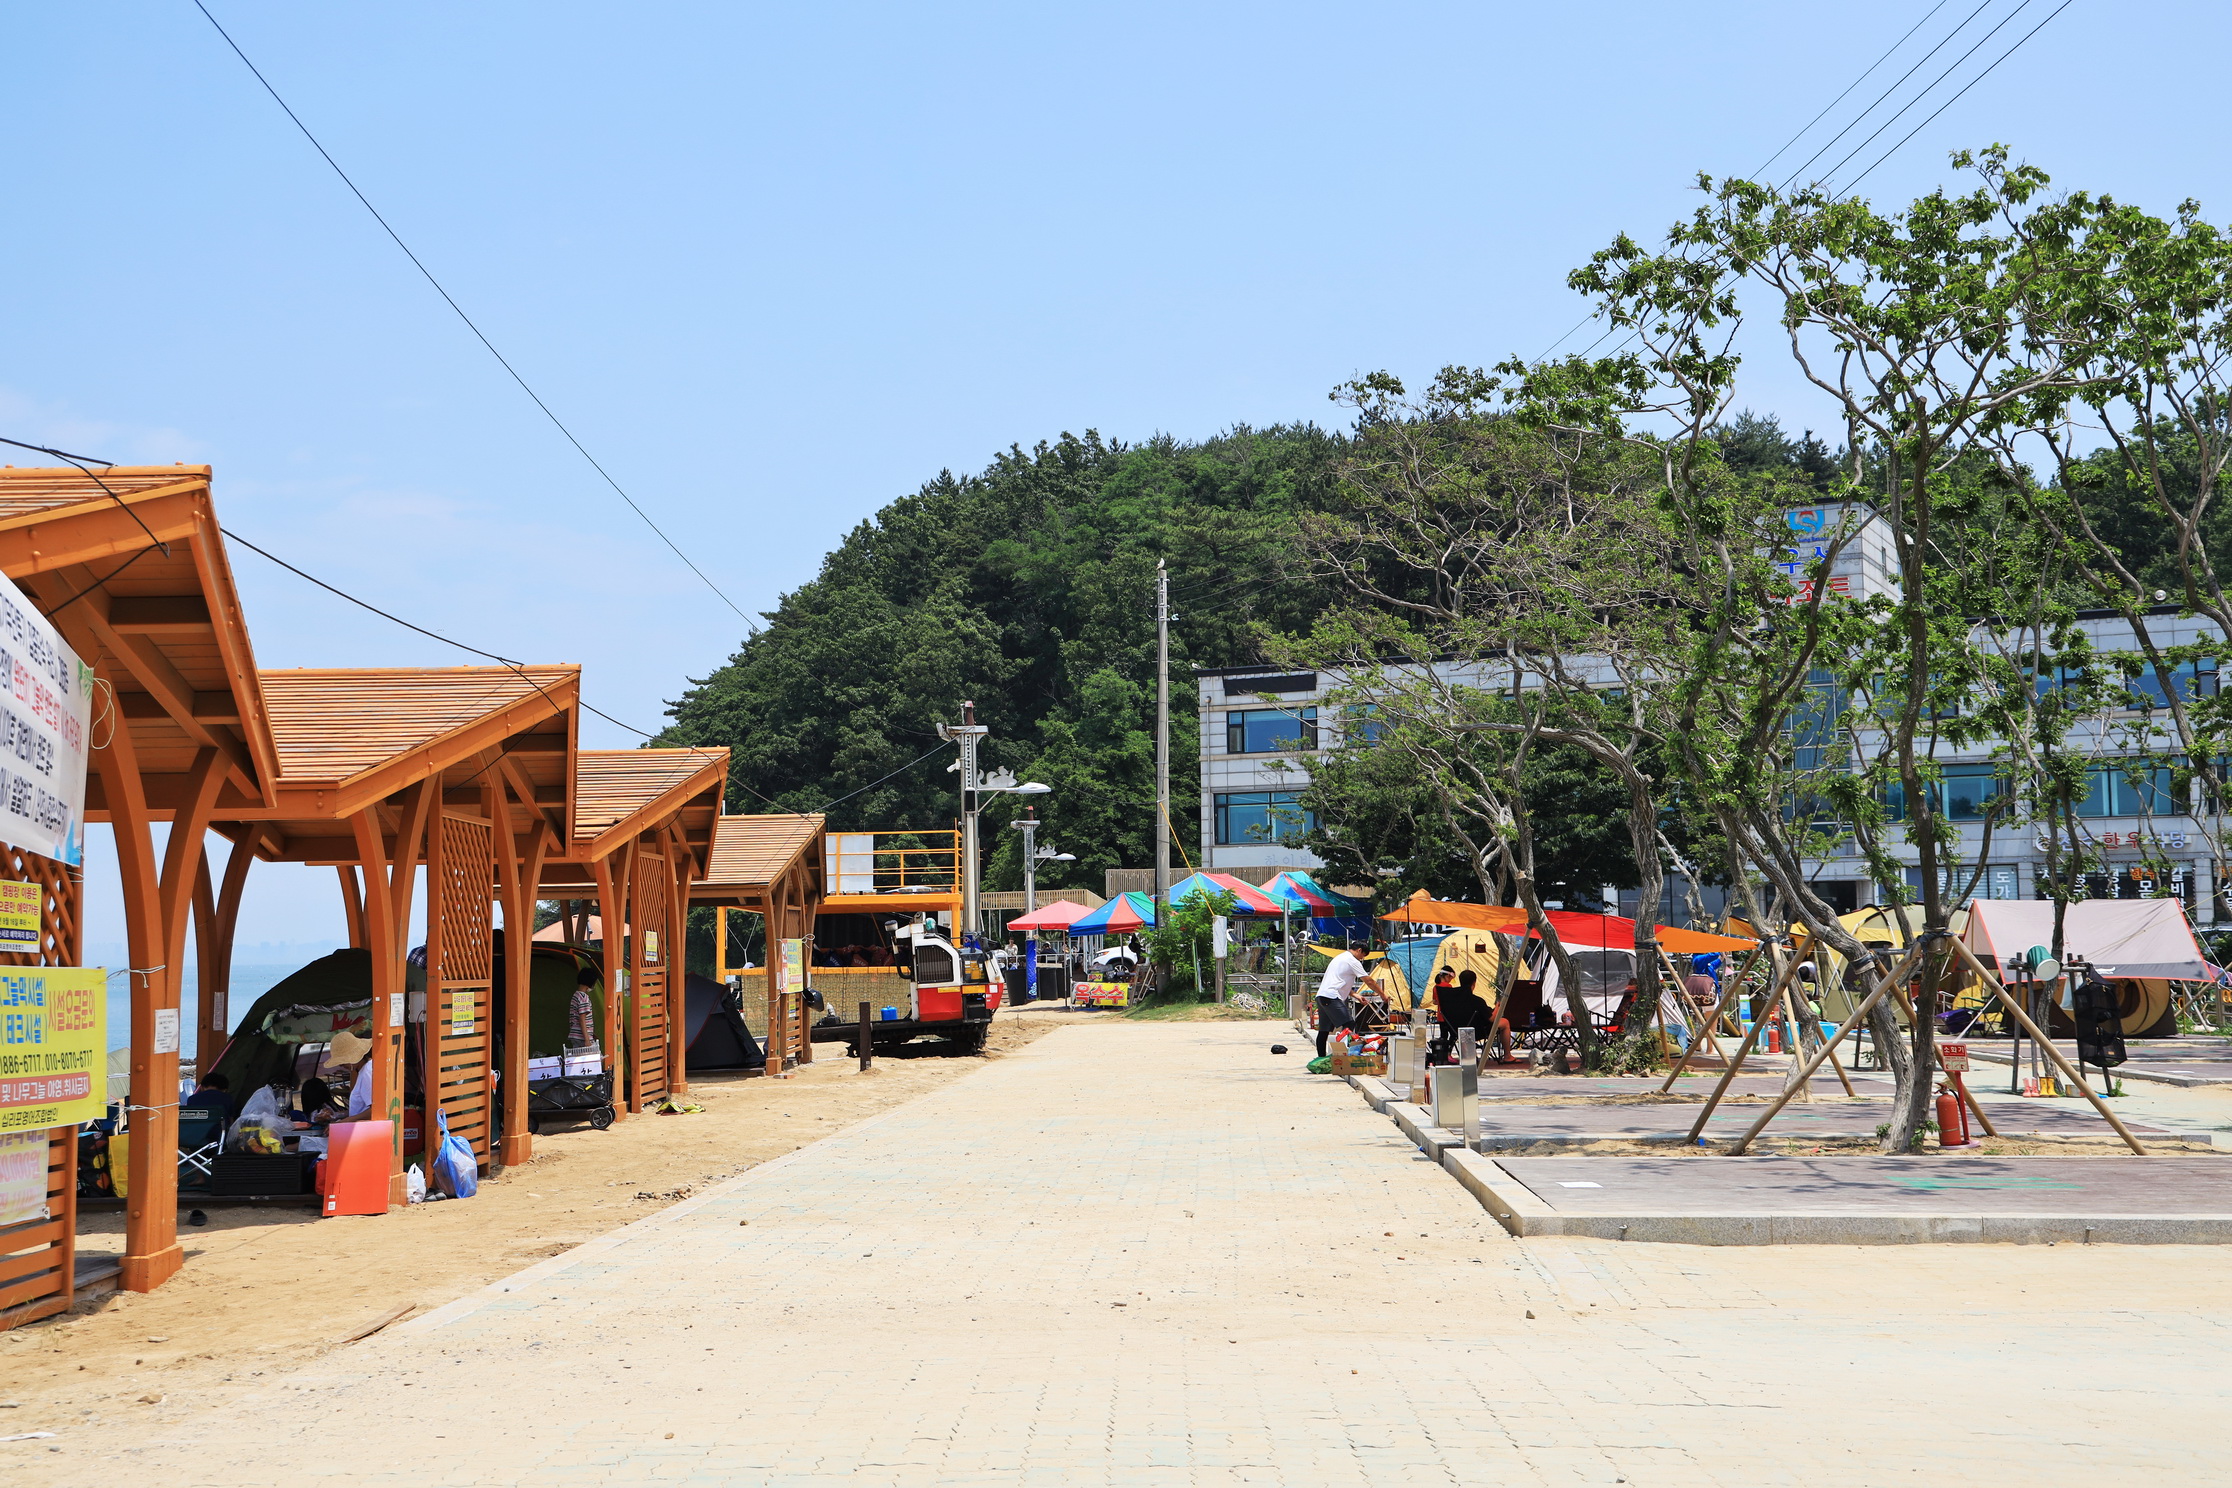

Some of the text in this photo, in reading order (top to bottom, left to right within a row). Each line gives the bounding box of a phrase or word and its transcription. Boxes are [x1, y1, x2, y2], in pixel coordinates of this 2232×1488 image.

[21, 887, 38, 900] 이용은
[1075, 984, 1124, 1004] 옥수수
[48, 989, 96, 1032] 시설요금문의
[1944, 1046, 1964, 1054] 소화기
[1, 1084, 11, 1103] 및
[13, 1081, 46, 1103] 나무그늘
[1, 1106, 59, 1128] 십리포영어조합법인
